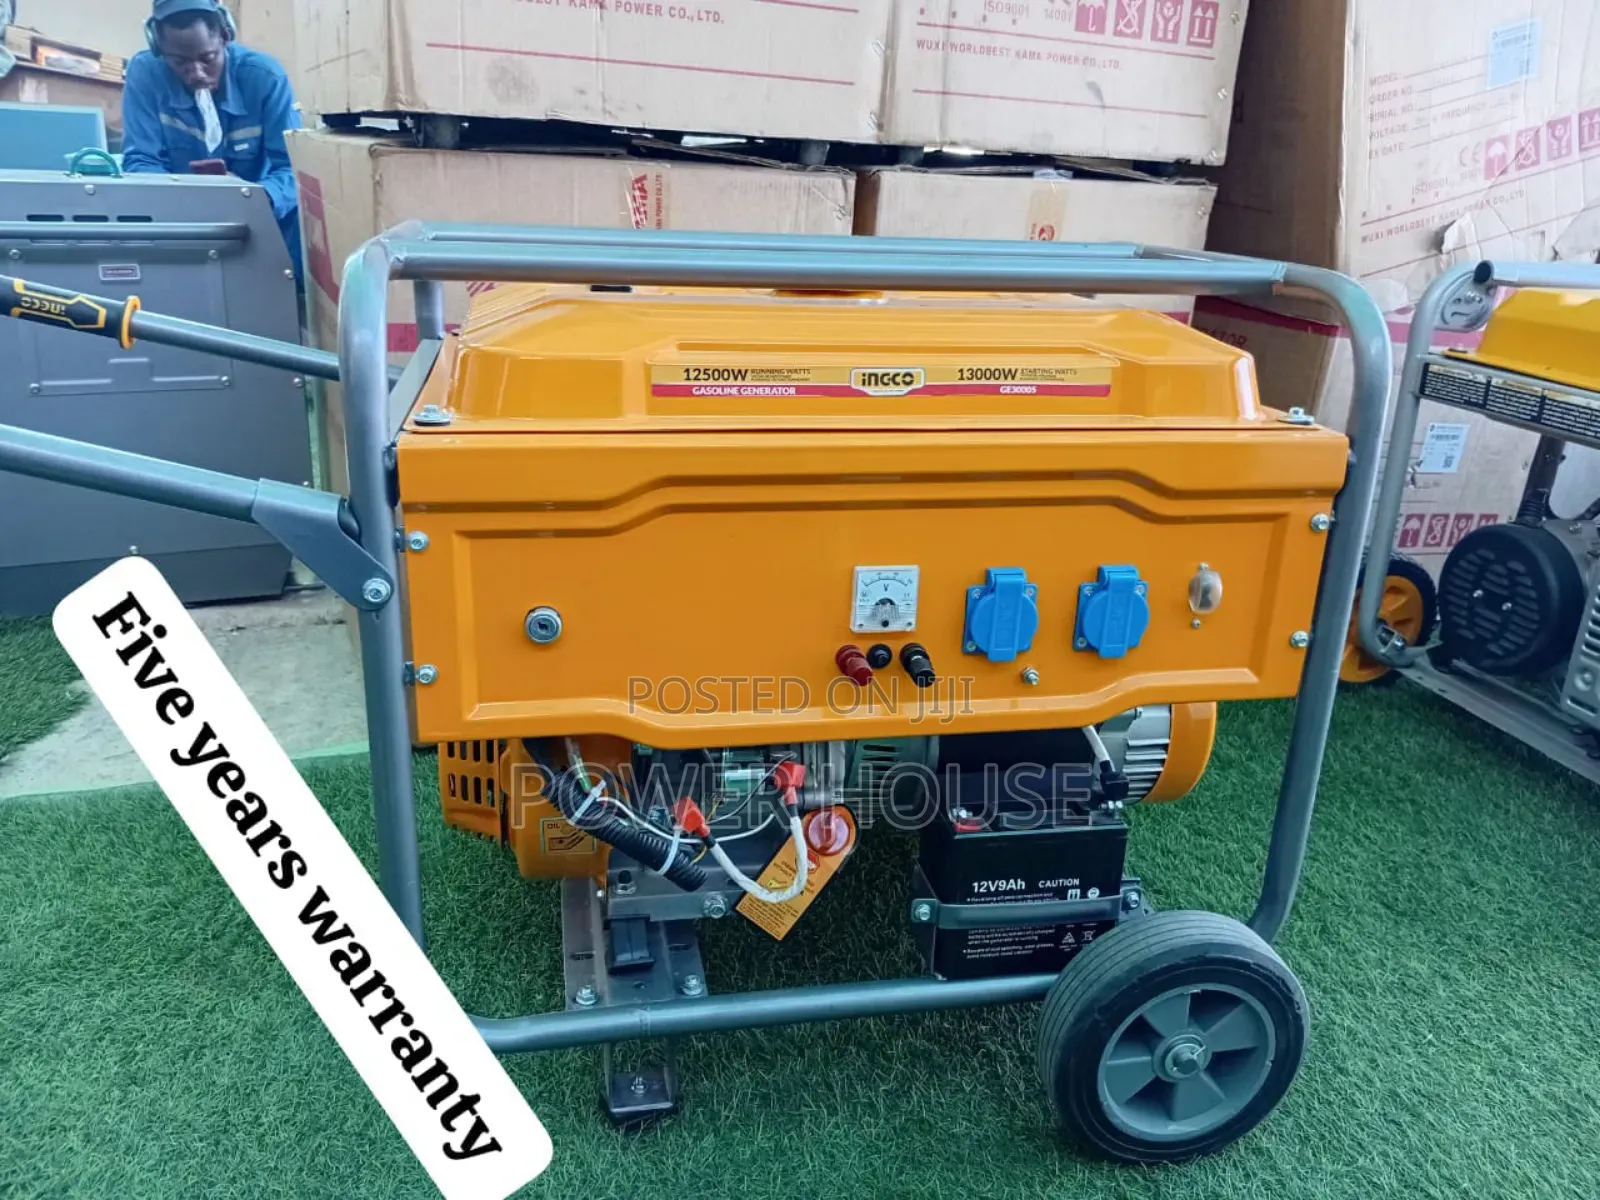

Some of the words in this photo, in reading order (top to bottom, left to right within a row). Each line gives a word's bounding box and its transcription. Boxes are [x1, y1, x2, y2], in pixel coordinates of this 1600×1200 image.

[614, 1, 663, 17] POWER
[983, 0, 1029, 17] ISO9001
[916, 39, 946, 51] WUXI
[950, 42, 1010, 58] WORLDBEST
[1014, 50, 1043, 61] KAMA
[1046, 54, 1080, 66] POWER
[683, 368, 748, 381] 12500W
[958, 367, 1018, 381] 13000W
[692, 386, 739, 396] GASOLINE
[740, 386, 796, 396] GENERATOR
[972, 878, 1026, 893] 12V9Ah
[1038, 878, 1080, 889] CAUTION
